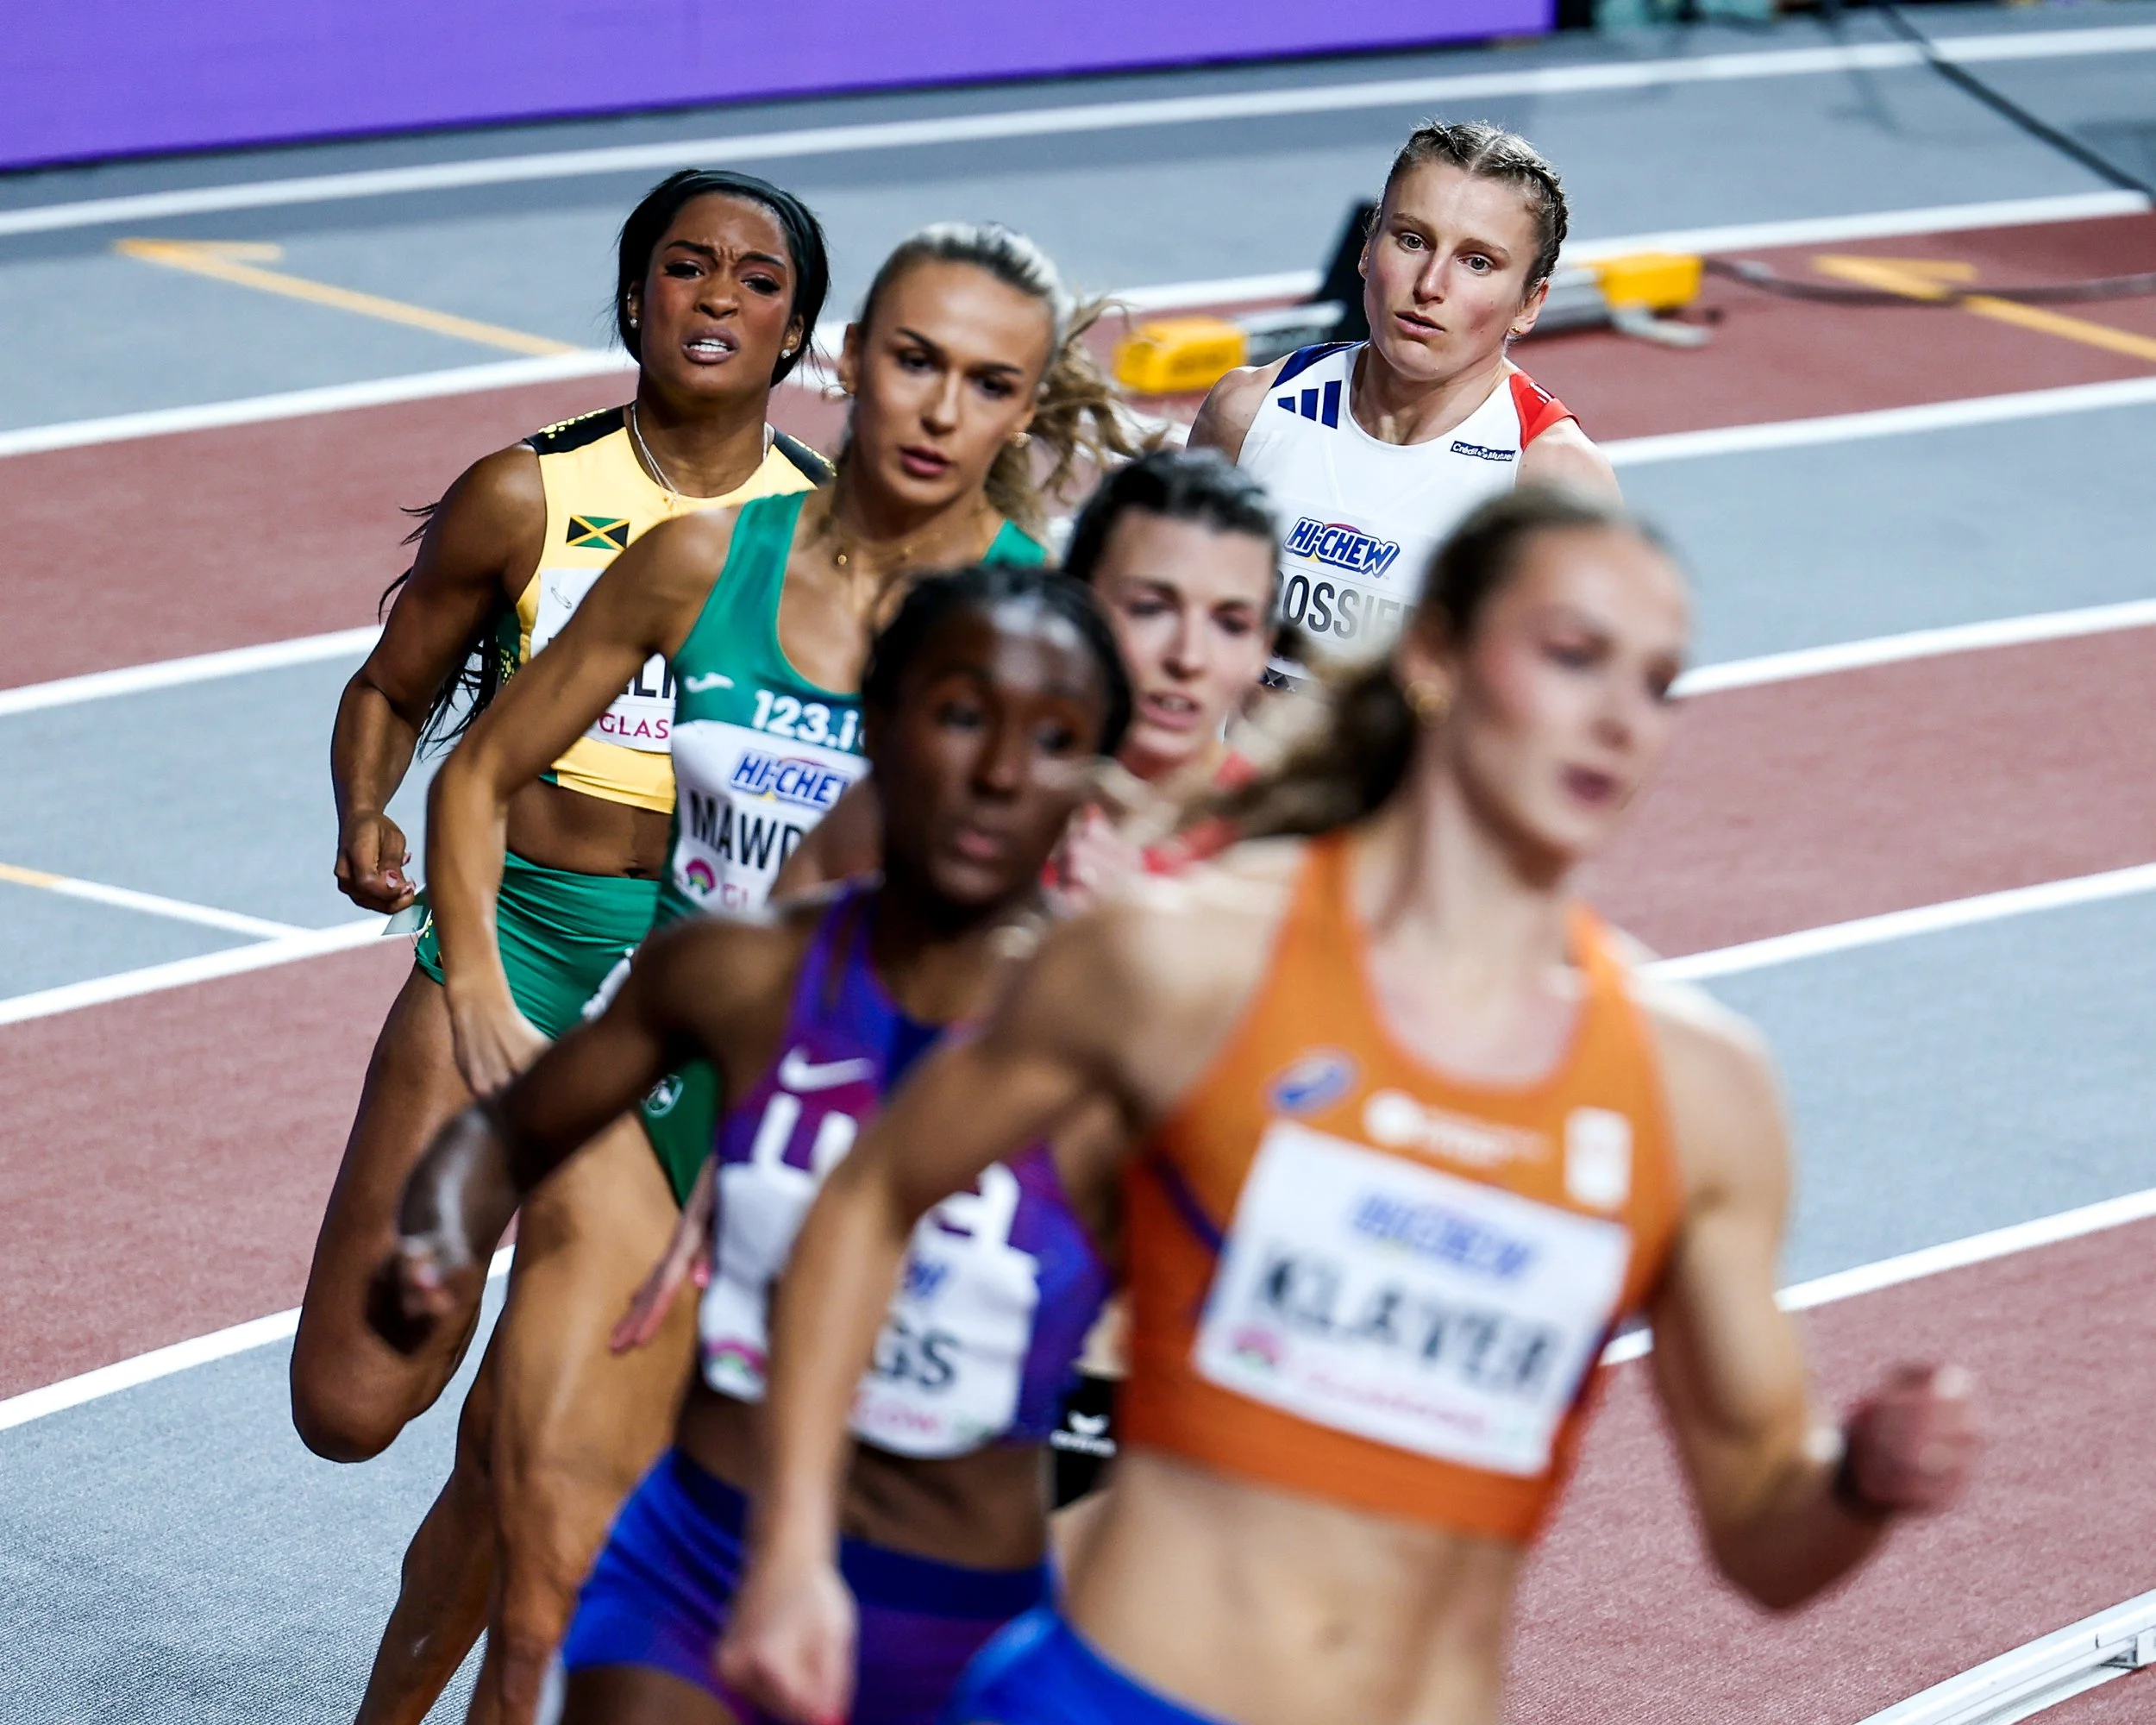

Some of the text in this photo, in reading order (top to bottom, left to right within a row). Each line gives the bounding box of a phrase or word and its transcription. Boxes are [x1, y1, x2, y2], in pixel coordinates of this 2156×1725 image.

[1452, 442, 1514, 461] Crédit Mutuel
[1284, 517, 1401, 579] HI-CHEW
[1274, 569, 1414, 647] OSSIE
